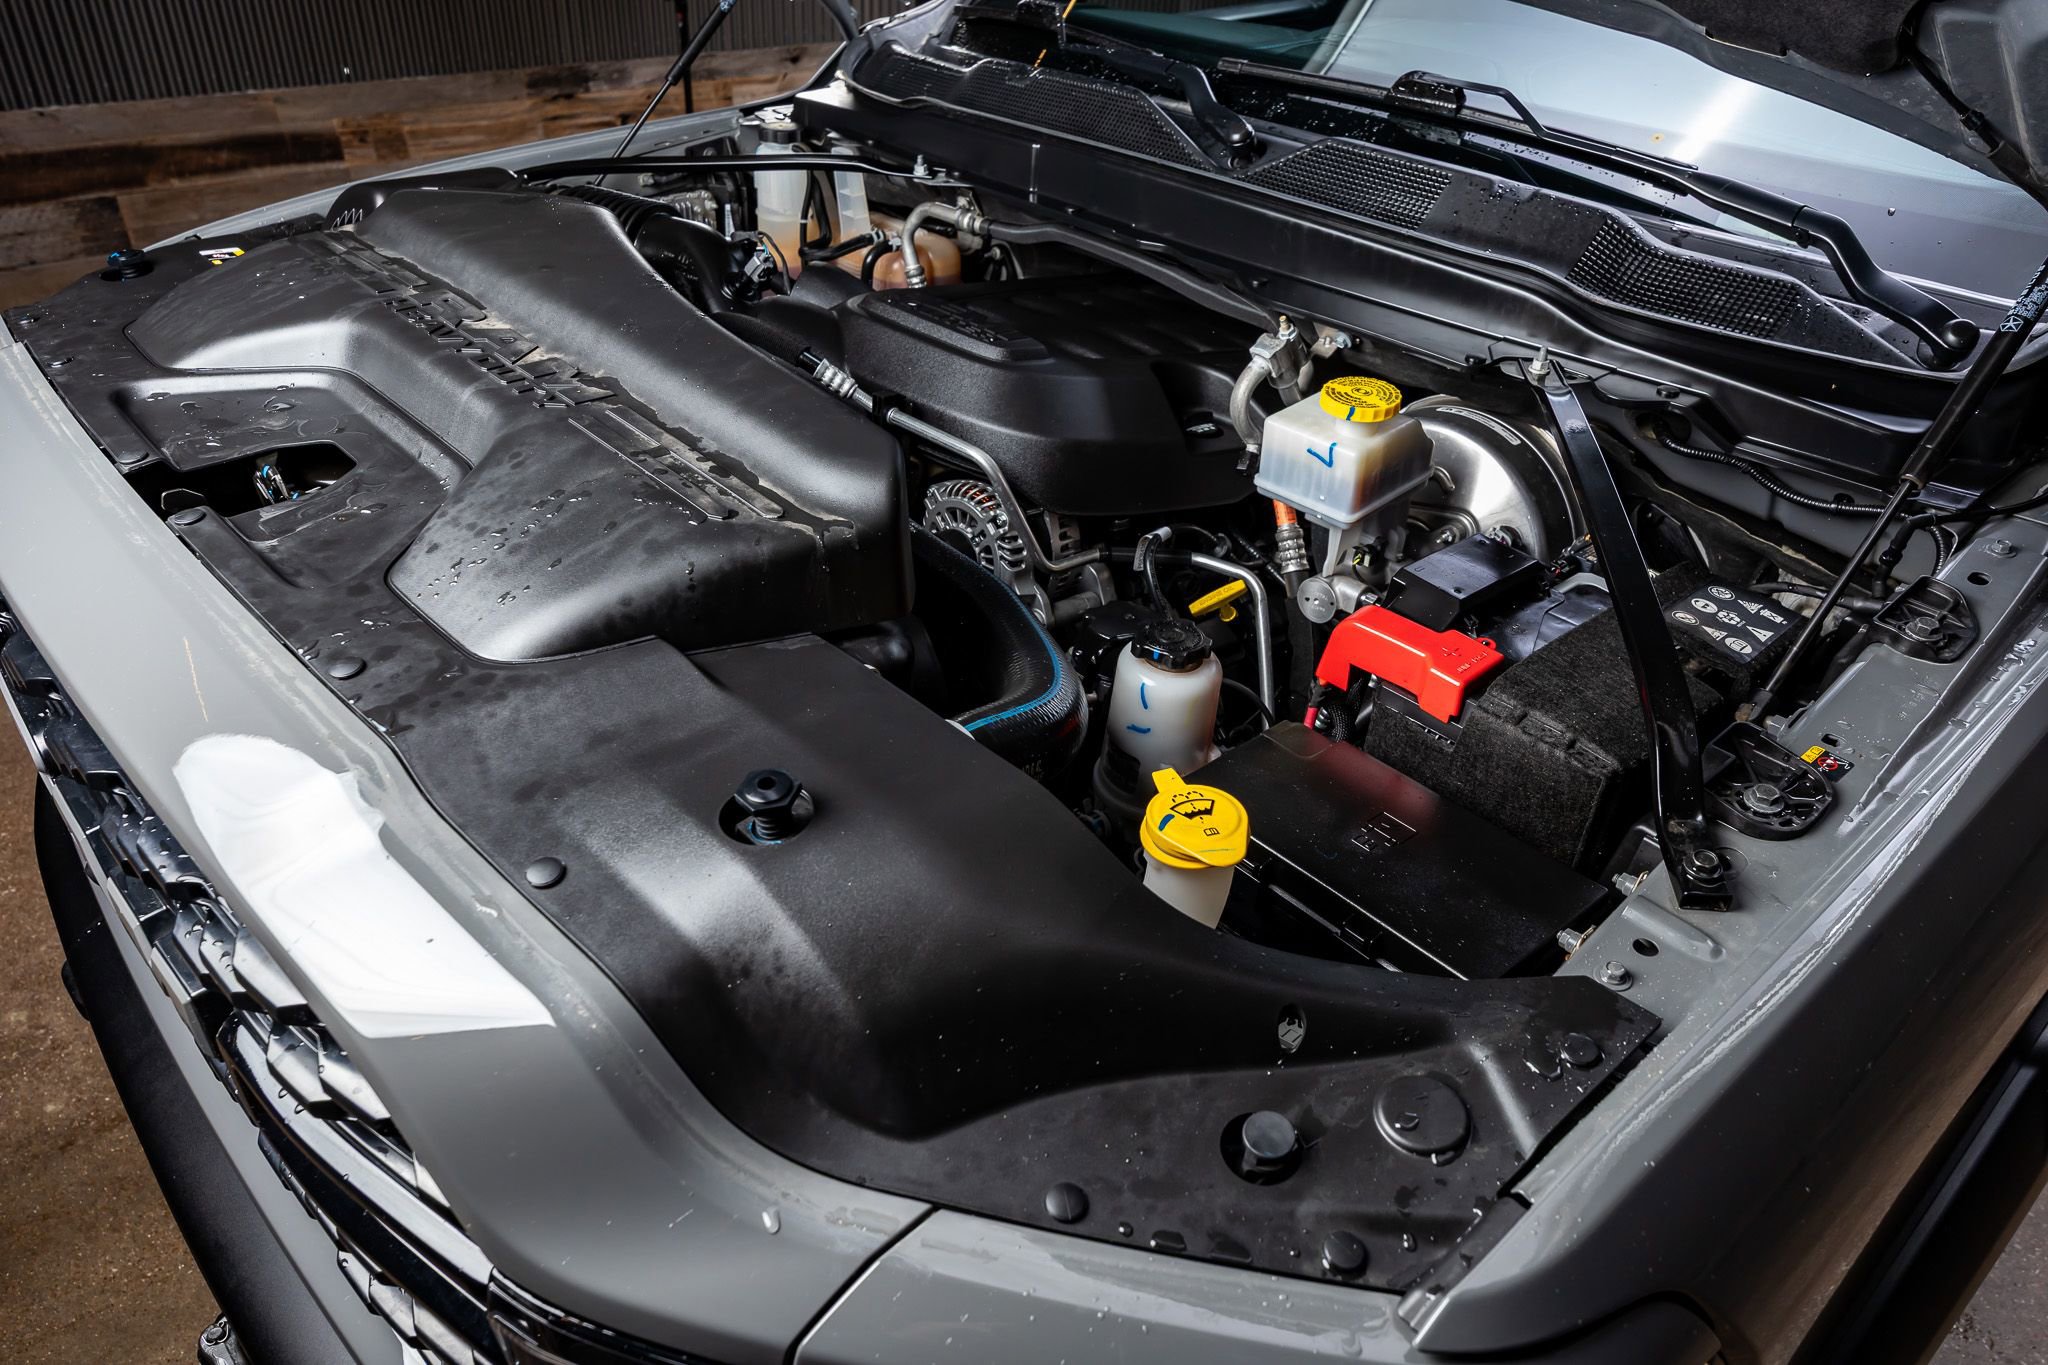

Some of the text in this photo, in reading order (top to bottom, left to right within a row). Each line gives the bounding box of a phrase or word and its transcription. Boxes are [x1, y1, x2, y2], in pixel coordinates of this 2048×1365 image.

[384, 298, 569, 409] HEAVY DUTY
[405, 290, 618, 406] RAM
